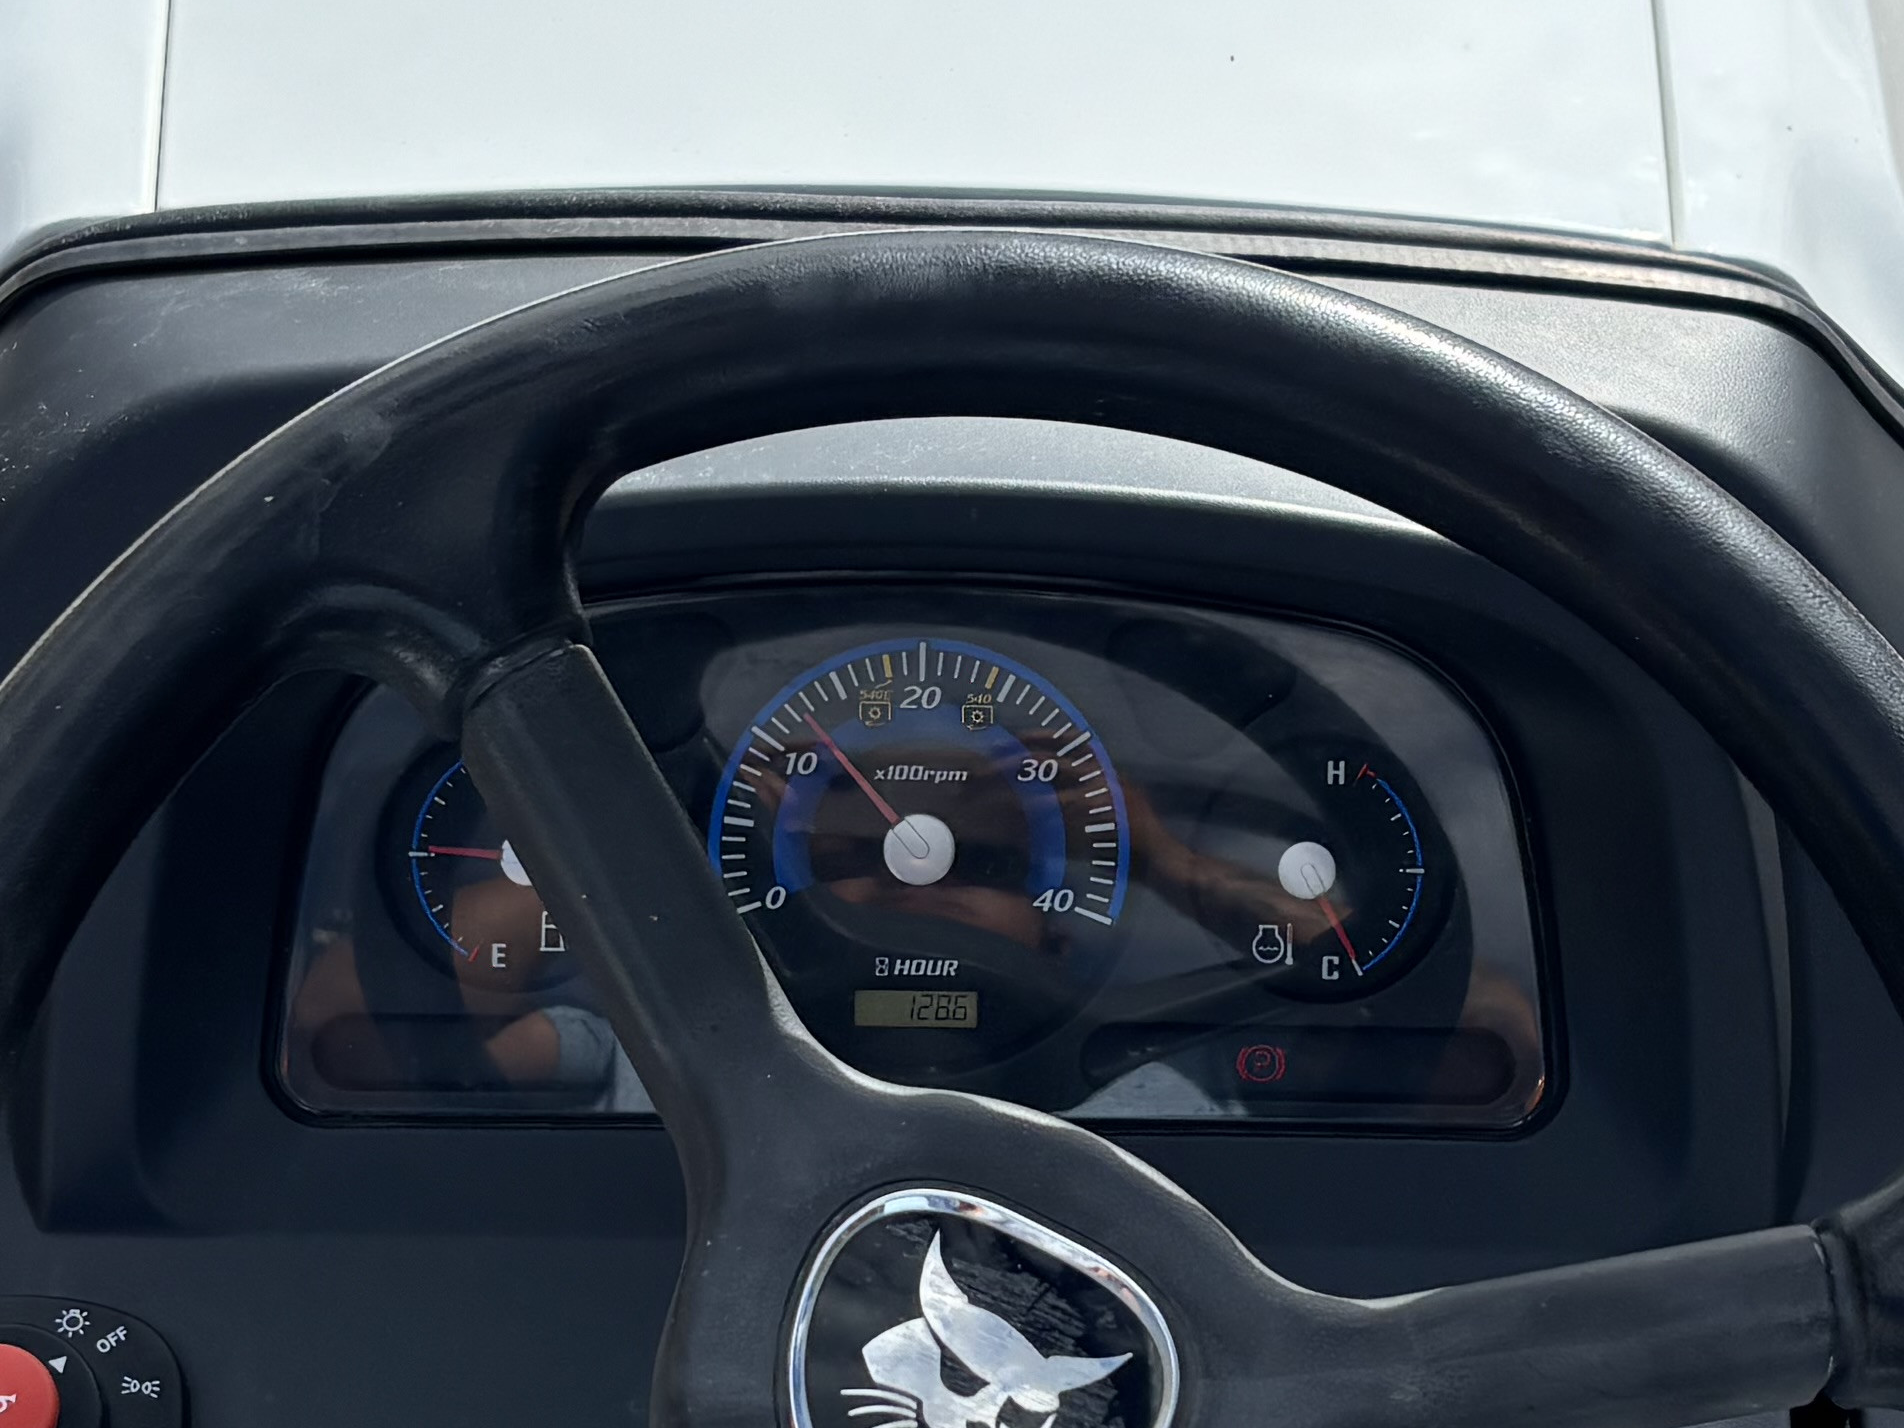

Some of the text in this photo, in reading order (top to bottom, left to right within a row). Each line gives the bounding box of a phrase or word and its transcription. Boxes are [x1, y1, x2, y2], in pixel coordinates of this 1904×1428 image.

[900, 686, 942, 709] 20
[966, 693, 992, 704] 540
[785, 752, 818, 776] 10
[874, 765, 968, 784] x100rpm
[1017, 759, 1059, 783] 30
[1327, 760, 1345, 785] H
[765, 885, 787, 910] 0
[1032, 888, 1074, 913] 40
[491, 943, 507, 968] E
[893, 958, 959, 976] HOUR
[1322, 955, 1340, 980] C
[96, 1325, 128, 1353] OFF
